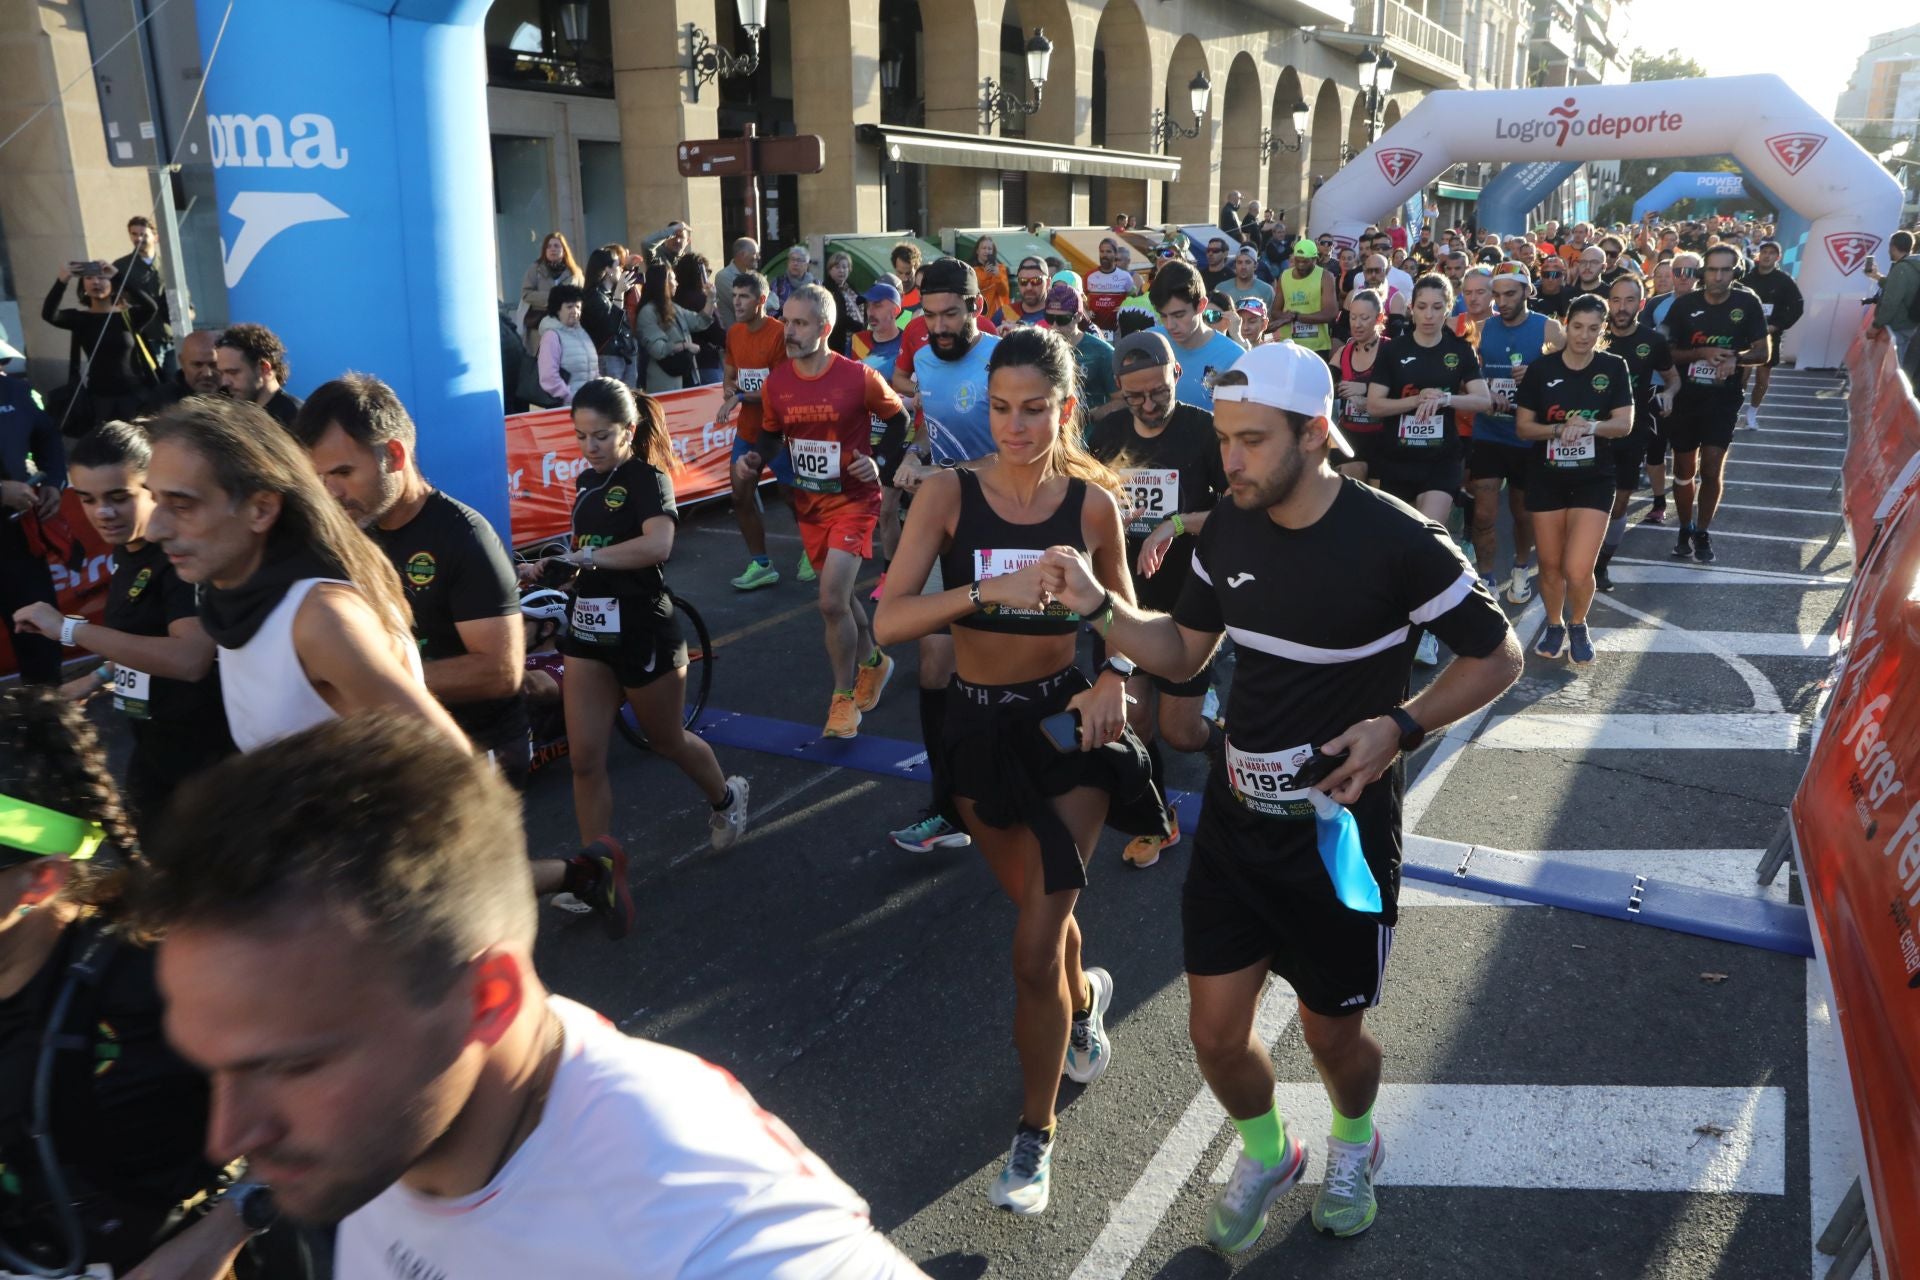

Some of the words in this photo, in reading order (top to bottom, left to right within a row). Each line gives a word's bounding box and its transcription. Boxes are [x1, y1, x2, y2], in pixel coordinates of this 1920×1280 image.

[1588, 110, 1683, 139] deporte
[207, 113, 348, 169] oma
[1696, 176, 1743, 186] POWER
[1696, 366, 1716, 375] 207
[1406, 425, 1435, 435] 1025
[1556, 447, 1586, 456] 1026
[798, 453, 828, 474] 402
[1004, 560, 1013, 569] LA
[576, 611, 606, 626] 384
[1842, 693, 1903, 810] ferrer
[1236, 757, 1244, 768] LA
[1244, 761, 1282, 772] MARATÓN
[1236, 768, 1294, 792] 1192
[1254, 790, 1277, 799] DIEGO
